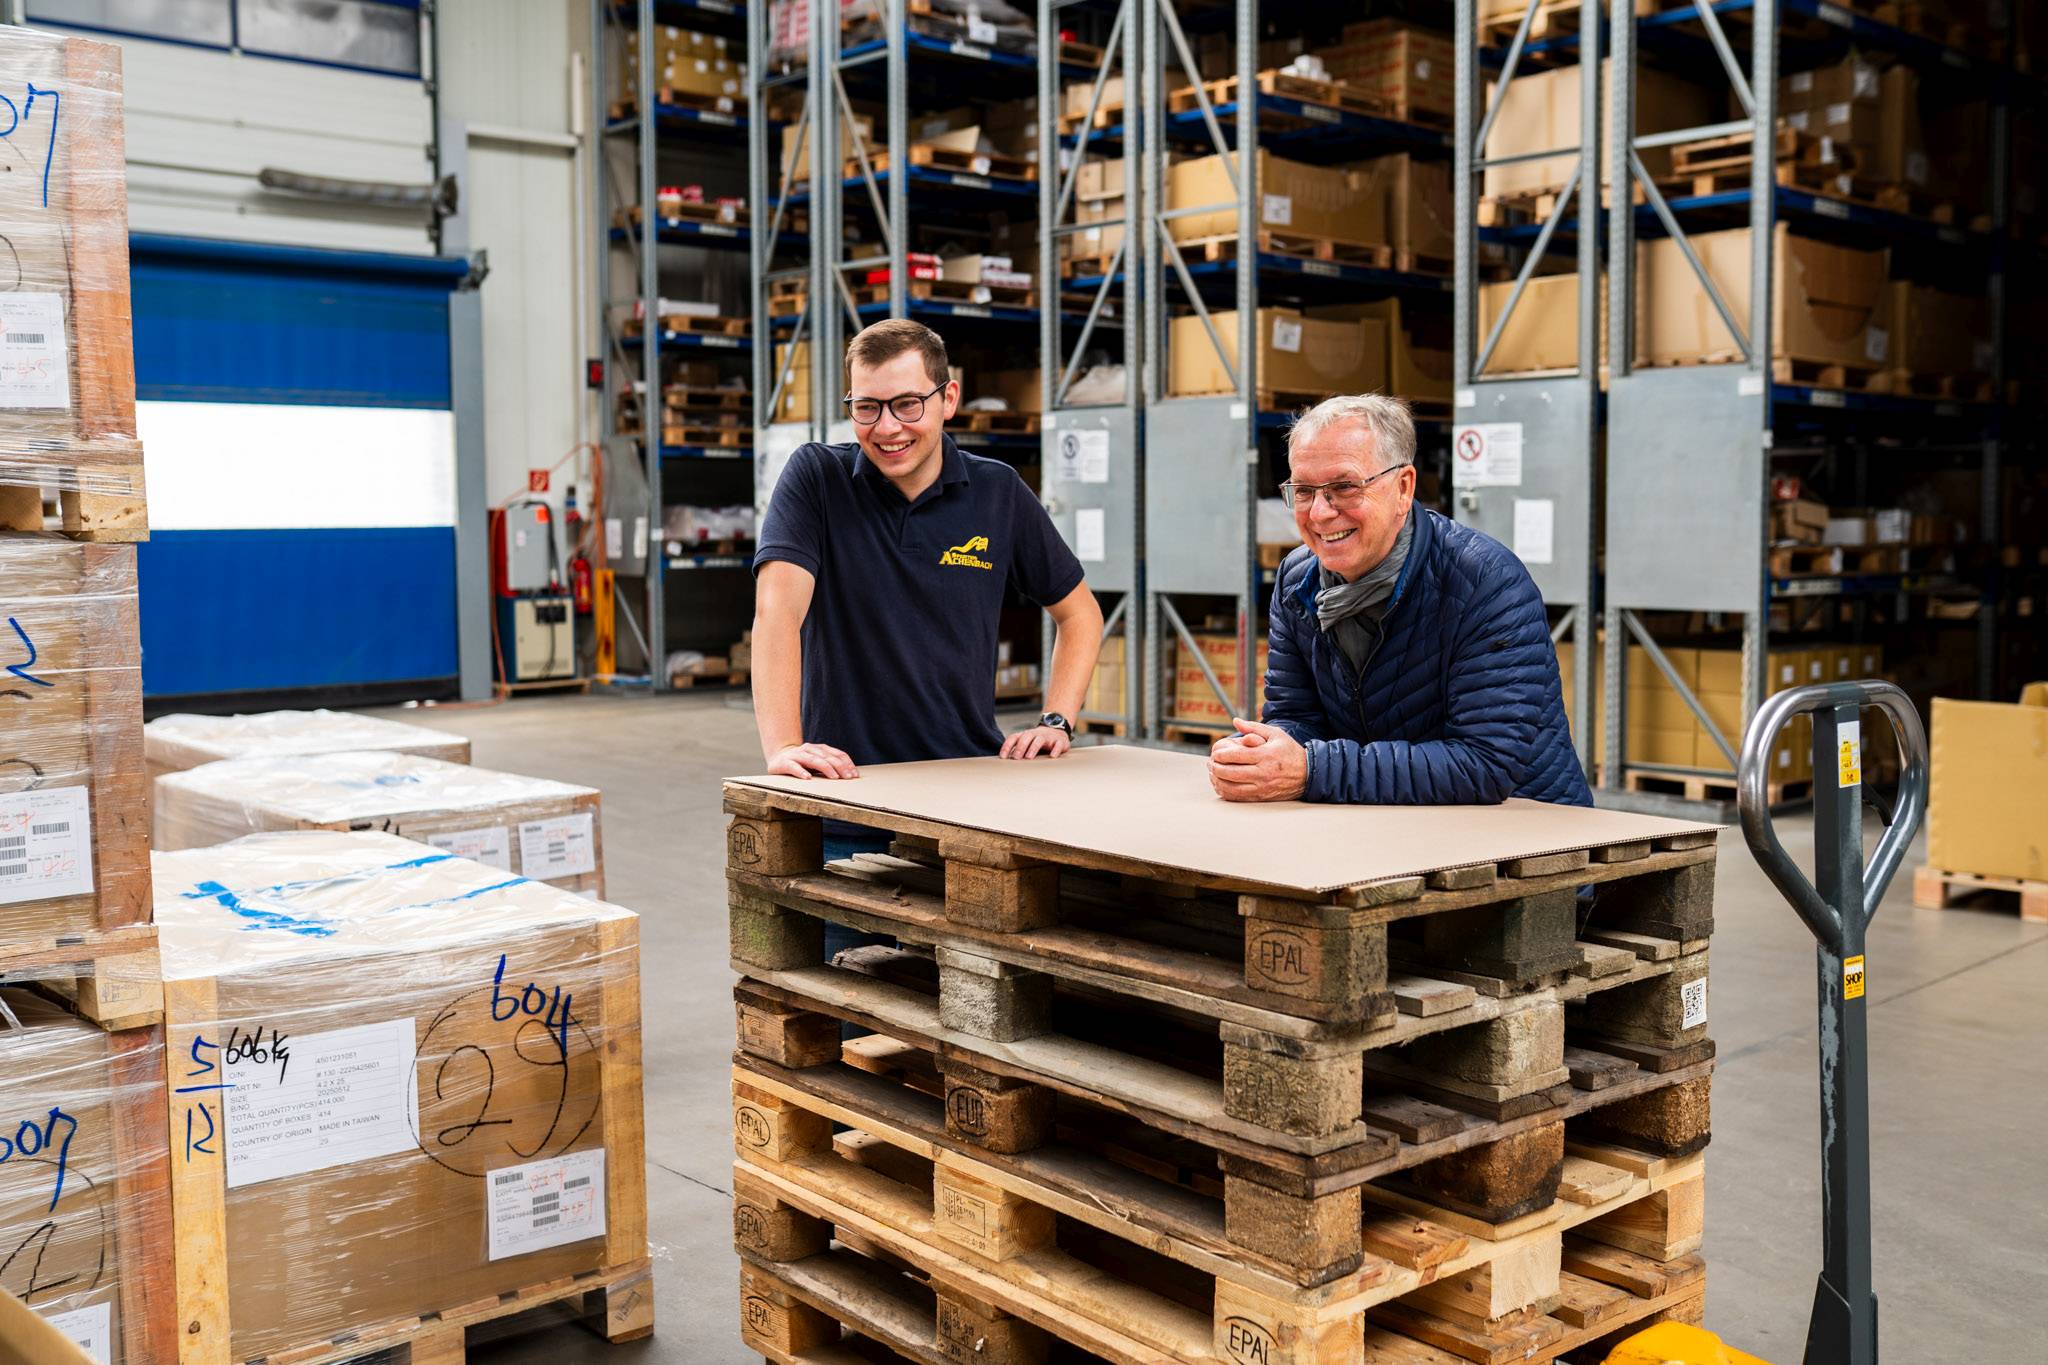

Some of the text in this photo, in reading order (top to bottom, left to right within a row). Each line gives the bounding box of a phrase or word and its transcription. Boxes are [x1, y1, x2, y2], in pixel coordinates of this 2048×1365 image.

[733, 831, 760, 857] EPAL
[1260, 940, 1309, 976] EPAL
[1845, 971, 1863, 986] SHOP
[490, 953, 584, 1058] 604
[230, 1095, 247, 1103] SIZE
[232, 1113, 256, 1122] TOTAL
[957, 1093, 984, 1129] EUR
[231, 1113, 312, 1135] QUANTITY OF BOXES
[319, 1114, 380, 1132] MADE IN TAIWAN
[232, 1126, 312, 1149] COUNTRY OF ORIGIN
